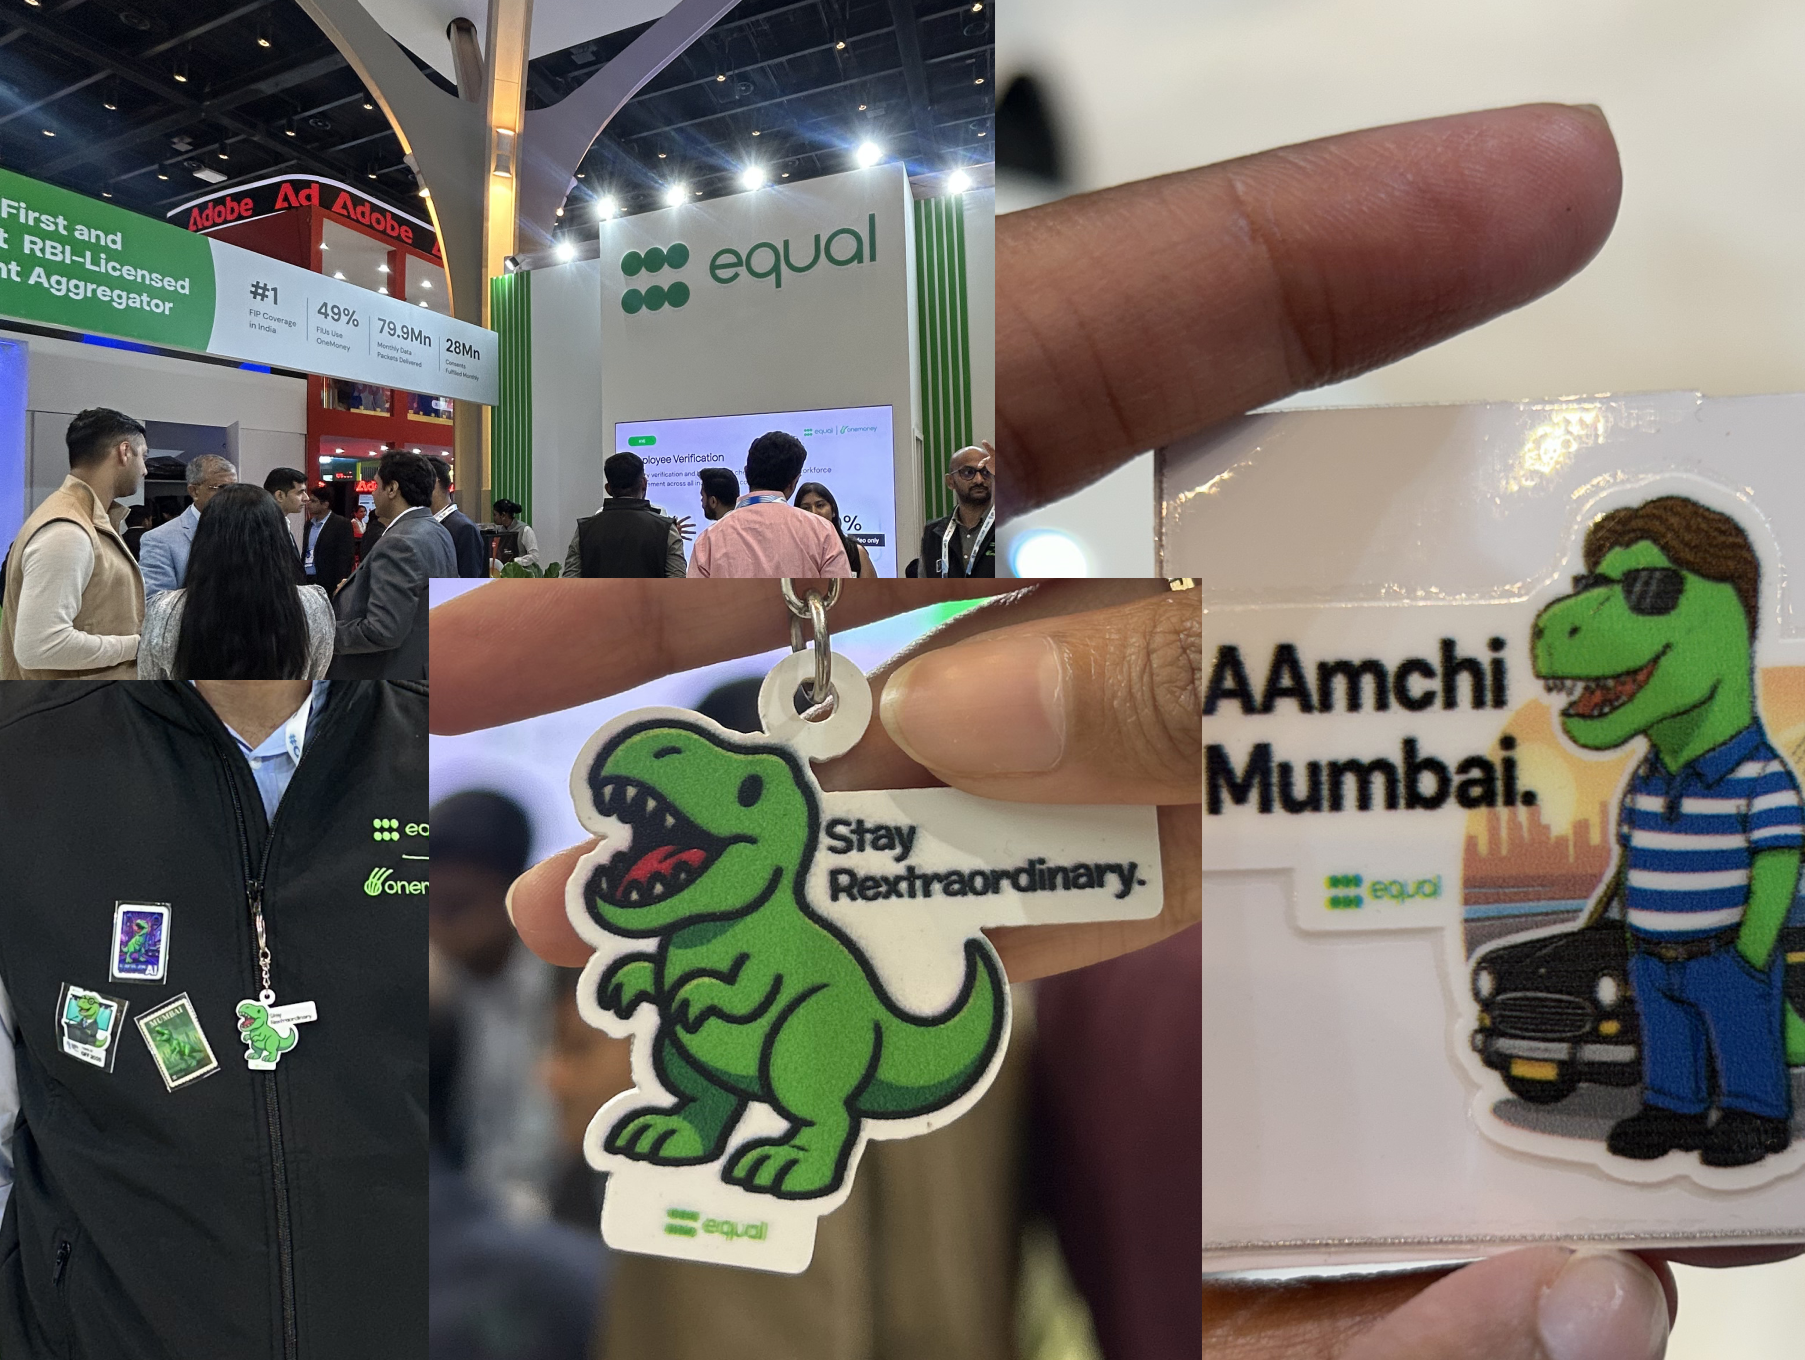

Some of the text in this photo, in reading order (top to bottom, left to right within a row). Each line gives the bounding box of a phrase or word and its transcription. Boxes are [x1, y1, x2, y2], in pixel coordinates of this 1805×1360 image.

[1, 197, 122, 250] First and
[188, 196, 254, 232] Adobe
[331, 191, 413, 244] Adobe
[709, 212, 877, 289] equal
[23, 234, 190, 294] RBI-Licensed
[28, 266, 173, 314] Aggregator
[249, 281, 278, 305] #1
[249, 309, 297, 328] FIP Coverage
[317, 301, 359, 327] 49%
[249, 321, 277, 334] in India
[316, 326, 343, 339] FIUs Use
[377, 317, 432, 347] 79.9Mn
[316, 337, 351, 353] OneMoney
[377, 341, 412, 356] Monthly Data
[446, 338, 480, 360] 28Mn
[377, 351, 422, 368] Packets Delivered
[446, 359, 466, 369] Consents
[847, 425, 877, 433] onemoney
[673, 453, 725, 464] Verification
[1202, 636, 1508, 716] AAmchi
[1204, 734, 1539, 815] Mumbai.
[825, 818, 917, 862] Stay
[828, 857, 1147, 902] Rextraordinary.
[1367, 874, 1442, 905] equal
[149, 1006, 184, 1028] MUMBAI
[702, 1217, 769, 1242] equal
